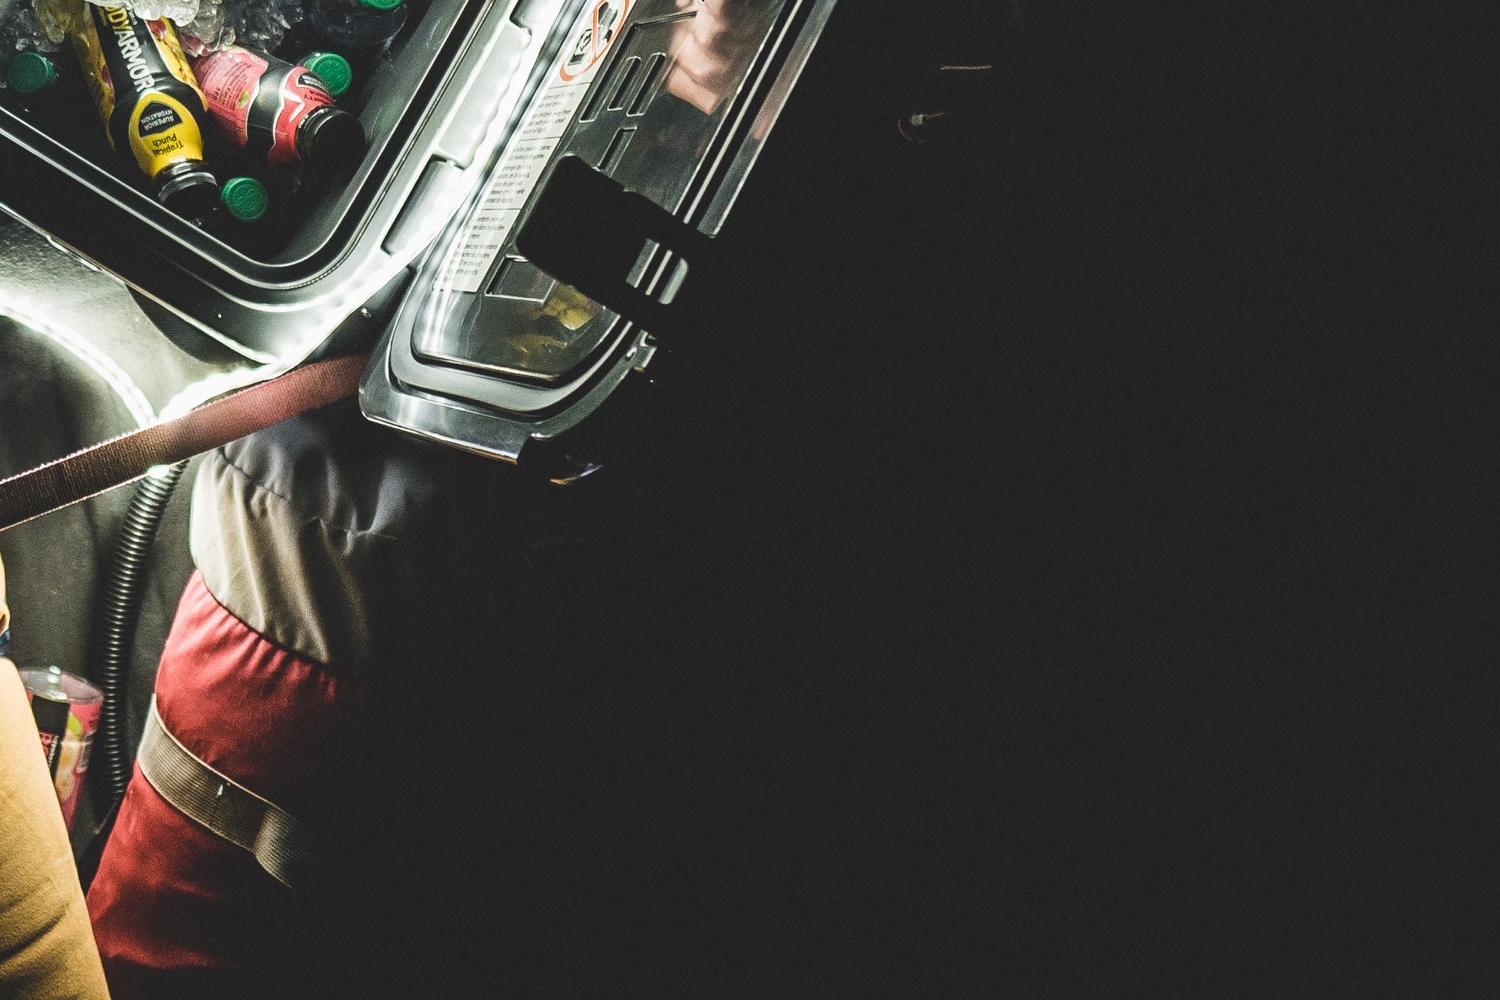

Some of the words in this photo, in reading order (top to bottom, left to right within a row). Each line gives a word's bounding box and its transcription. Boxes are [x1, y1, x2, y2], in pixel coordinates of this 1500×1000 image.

[105, 6, 156, 92] DYARMOR
[140, 108, 173, 124] HYDRATION
[143, 115, 175, 131] SUPERIOR
[151, 133, 177, 147] Punch
[151, 140, 184, 157] Tropical
